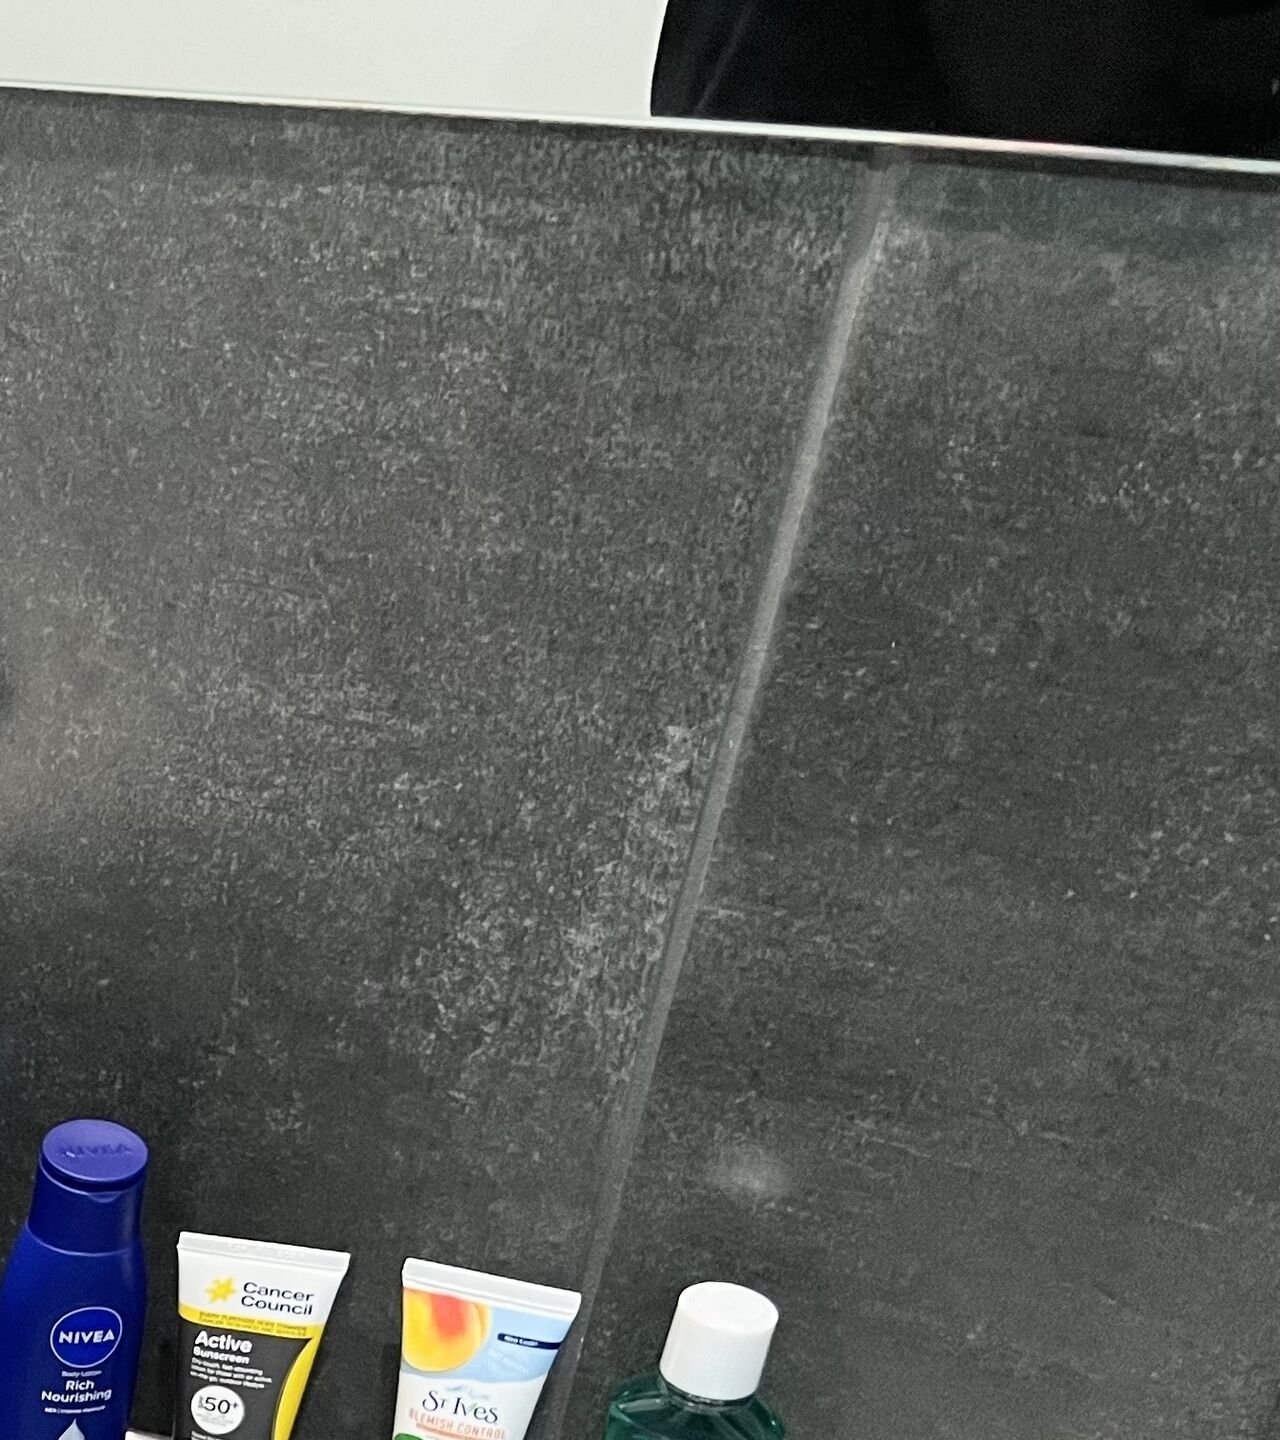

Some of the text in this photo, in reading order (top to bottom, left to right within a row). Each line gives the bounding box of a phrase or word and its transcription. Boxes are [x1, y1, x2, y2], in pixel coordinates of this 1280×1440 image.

[242, 1281, 315, 1301] Cancer
[241, 1295, 313, 1315] Council
[58, 1329, 115, 1344] NIVEA
[194, 1330, 253, 1353] Active
[193, 1345, 250, 1365] Sunscreen
[65, 1380, 95, 1391] Rich
[41, 1389, 112, 1403] Nourishing
[204, 1396, 239, 1415] 50+
[408, 1407, 508, 1440] BLEMISH CONTROL
